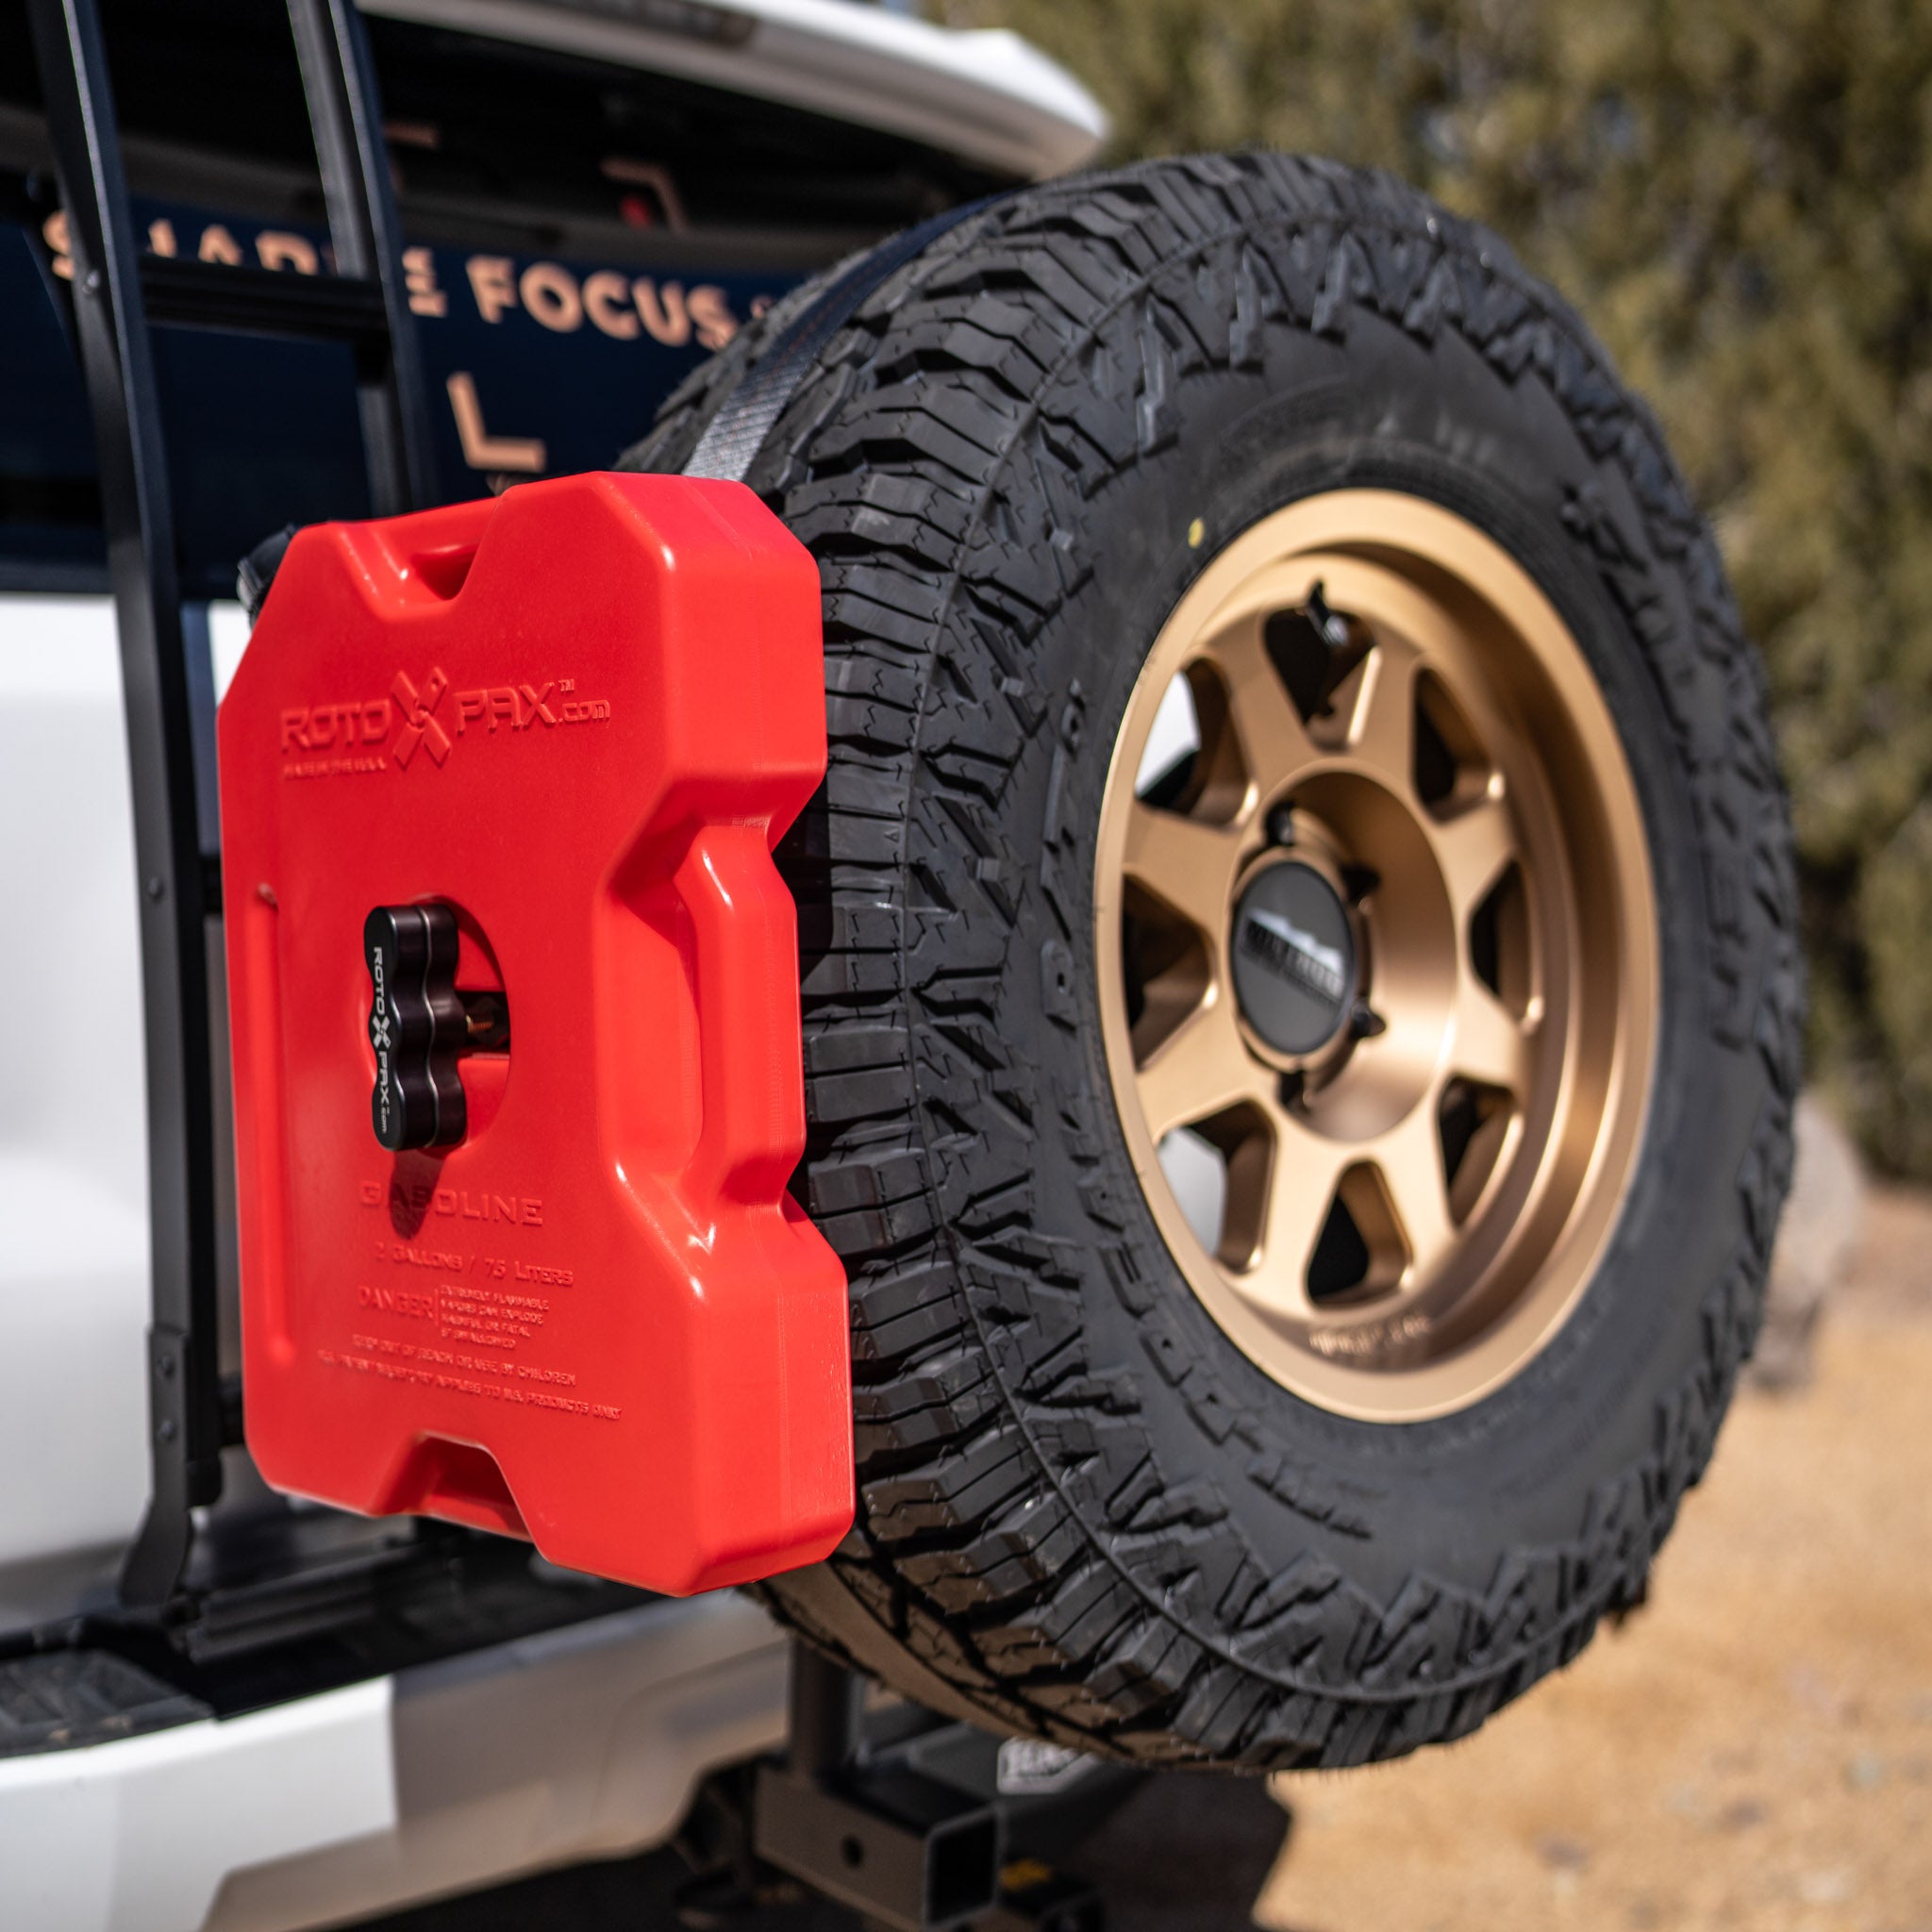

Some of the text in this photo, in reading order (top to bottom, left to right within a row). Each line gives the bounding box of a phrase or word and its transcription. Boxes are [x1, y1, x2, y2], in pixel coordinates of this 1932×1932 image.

[466, 255, 740, 353] FOCUS
[281, 699, 391, 753] ROTO
[374, 945, 386, 1016] ROTO
[360, 1180, 543, 1226] GASOLINE
[391, 1243, 463, 1273] GALLONS
[514, 1261, 575, 1287] LITERS
[358, 1285, 435, 1321] DANGER
[518, 1365, 576, 1388] CHILDREN
